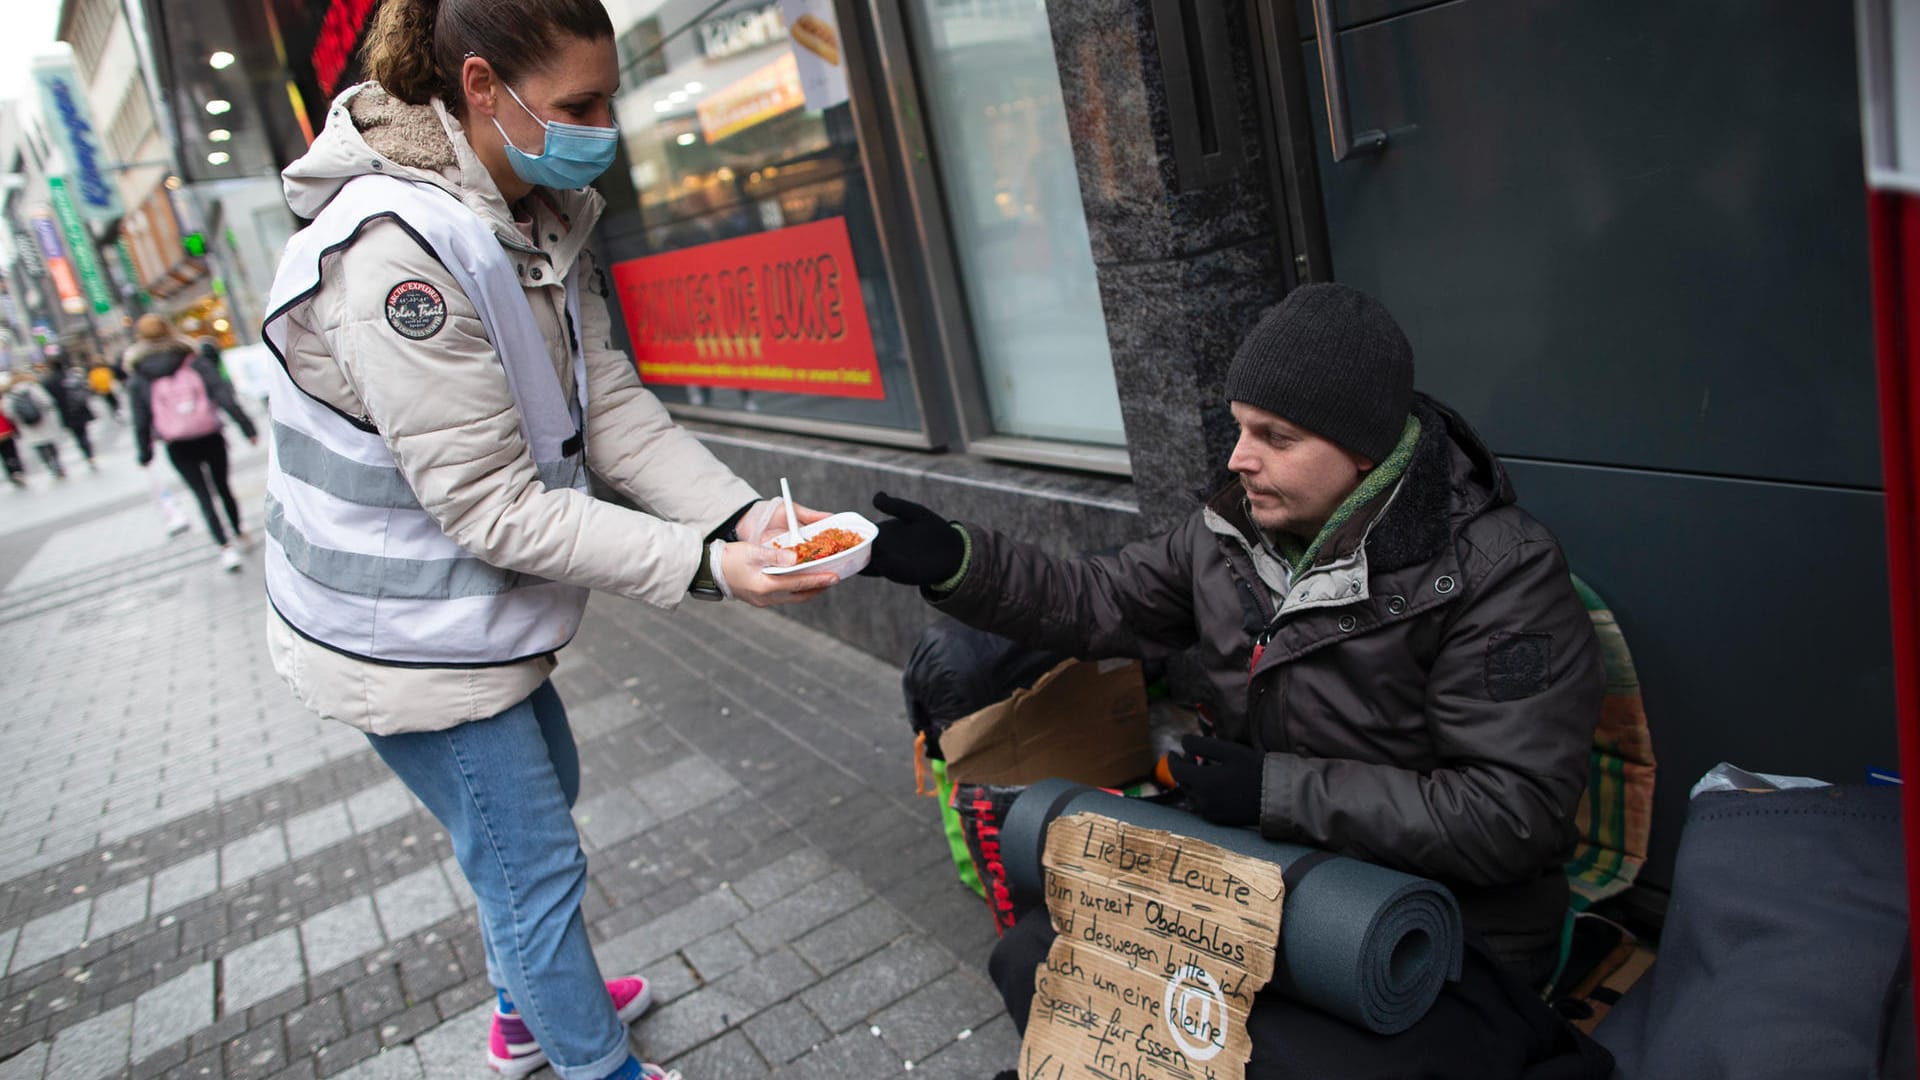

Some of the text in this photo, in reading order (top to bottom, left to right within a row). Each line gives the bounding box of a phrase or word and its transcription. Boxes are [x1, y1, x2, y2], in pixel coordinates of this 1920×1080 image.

[417, 303, 443, 317] Trail
[763, 253, 847, 342] LUXE
[1083, 823, 1250, 905] Liebe Leute
[1048, 872, 1246, 962] Bin zurzeit Obdachlos
[1053, 909, 1249, 1001] nd deswegen bitte ich
[1039, 977, 1100, 1027] Spende
[1135, 1024, 1190, 1071] Essen
[1169, 992, 1225, 1049] kleine
